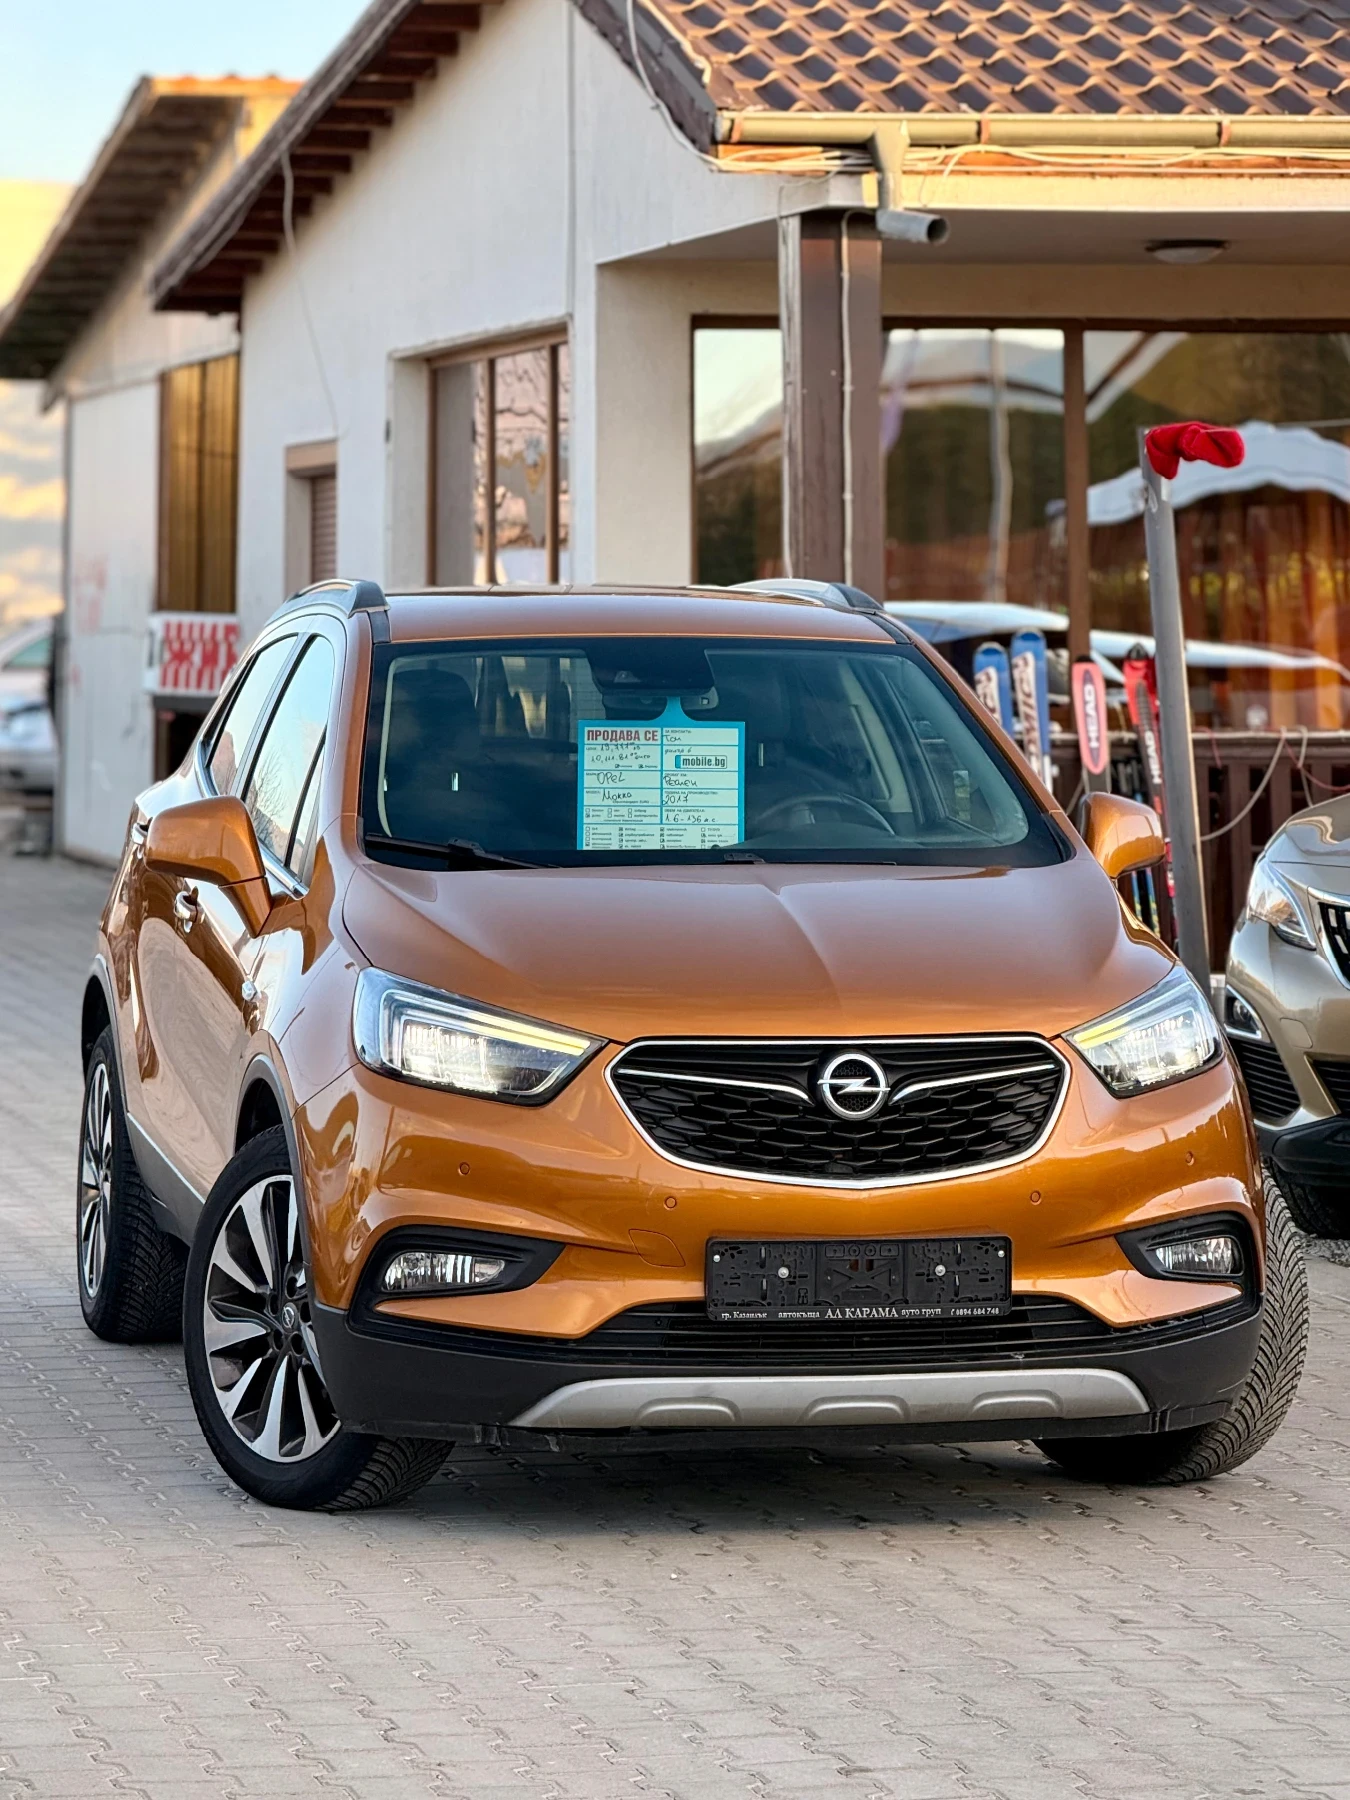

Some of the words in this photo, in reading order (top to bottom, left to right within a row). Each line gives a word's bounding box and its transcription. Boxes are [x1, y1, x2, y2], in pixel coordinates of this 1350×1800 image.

[1083, 683, 1100, 749] HEAD
[587, 729, 640, 742] ПРОДАВА
[644, 730, 659, 742] СЕ
[682, 756, 726, 768] mobile.bg
[1143, 730, 1163, 785] HEAD
[661, 793, 689, 806] 2017
[778, 1311, 820, 1319] автокъща
[845, 1307, 899, 1319] КАРАМА
[901, 1309, 920, 1318] ауто
[921, 1308, 942, 1318] груп
